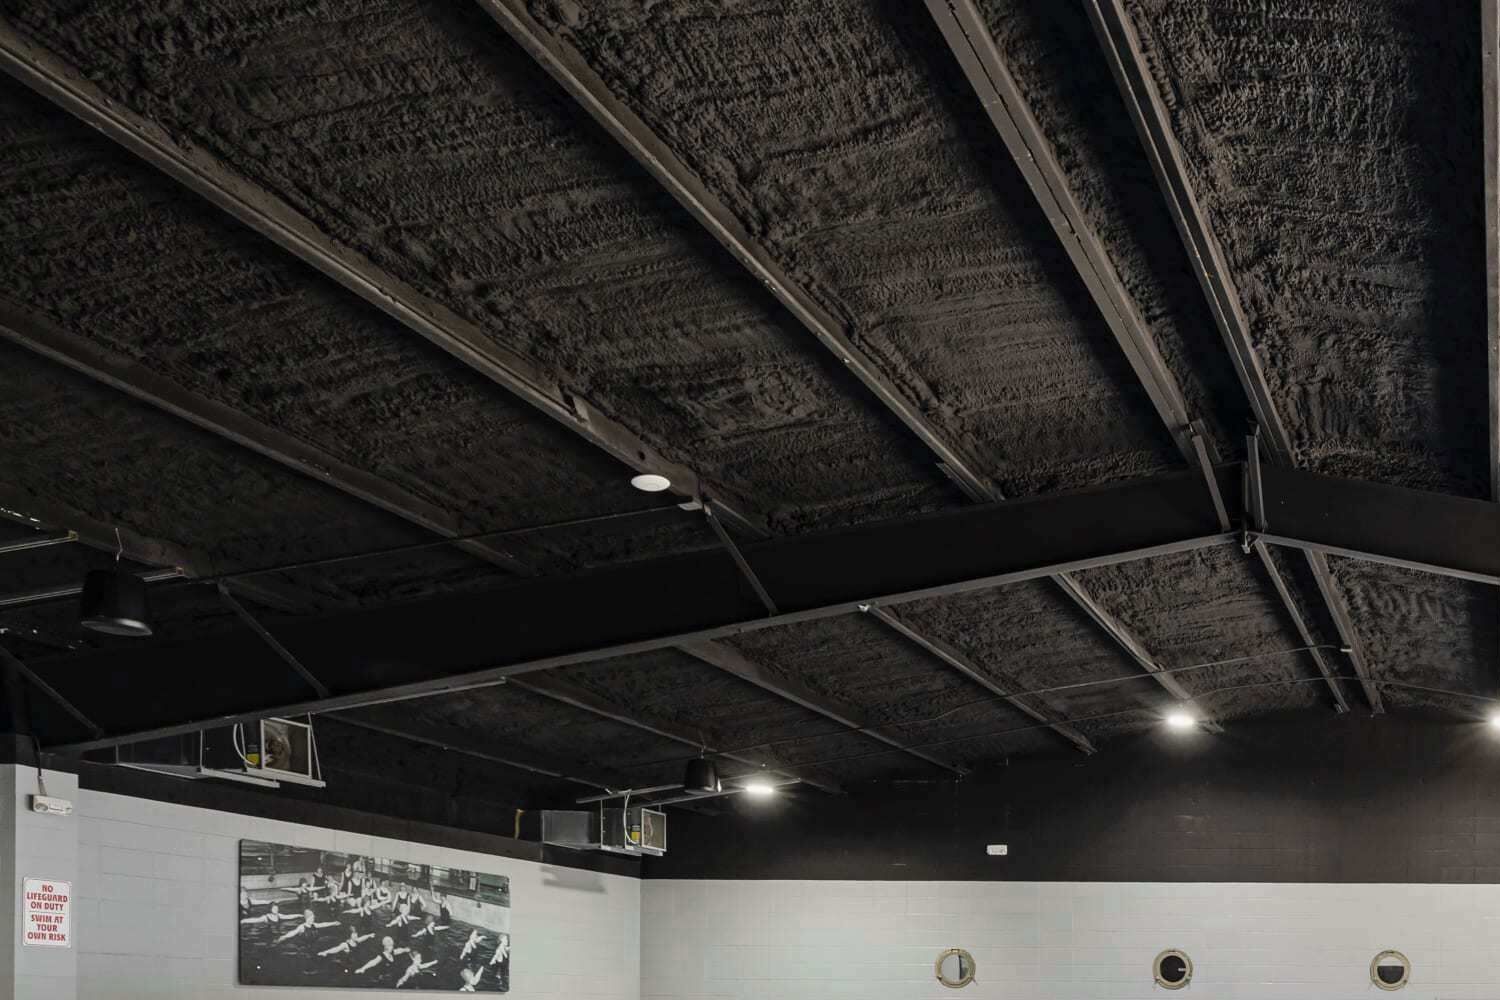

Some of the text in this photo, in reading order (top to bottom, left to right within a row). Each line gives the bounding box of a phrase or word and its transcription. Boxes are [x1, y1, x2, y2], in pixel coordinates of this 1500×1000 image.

[27, 892, 68, 903] LIFEGUARD
[31, 901, 64, 911] ON DUTY
[31, 914, 64, 924] SWIM AT
[37, 923, 58, 932] YOUR
[27, 931, 66, 941] OWN RISK
